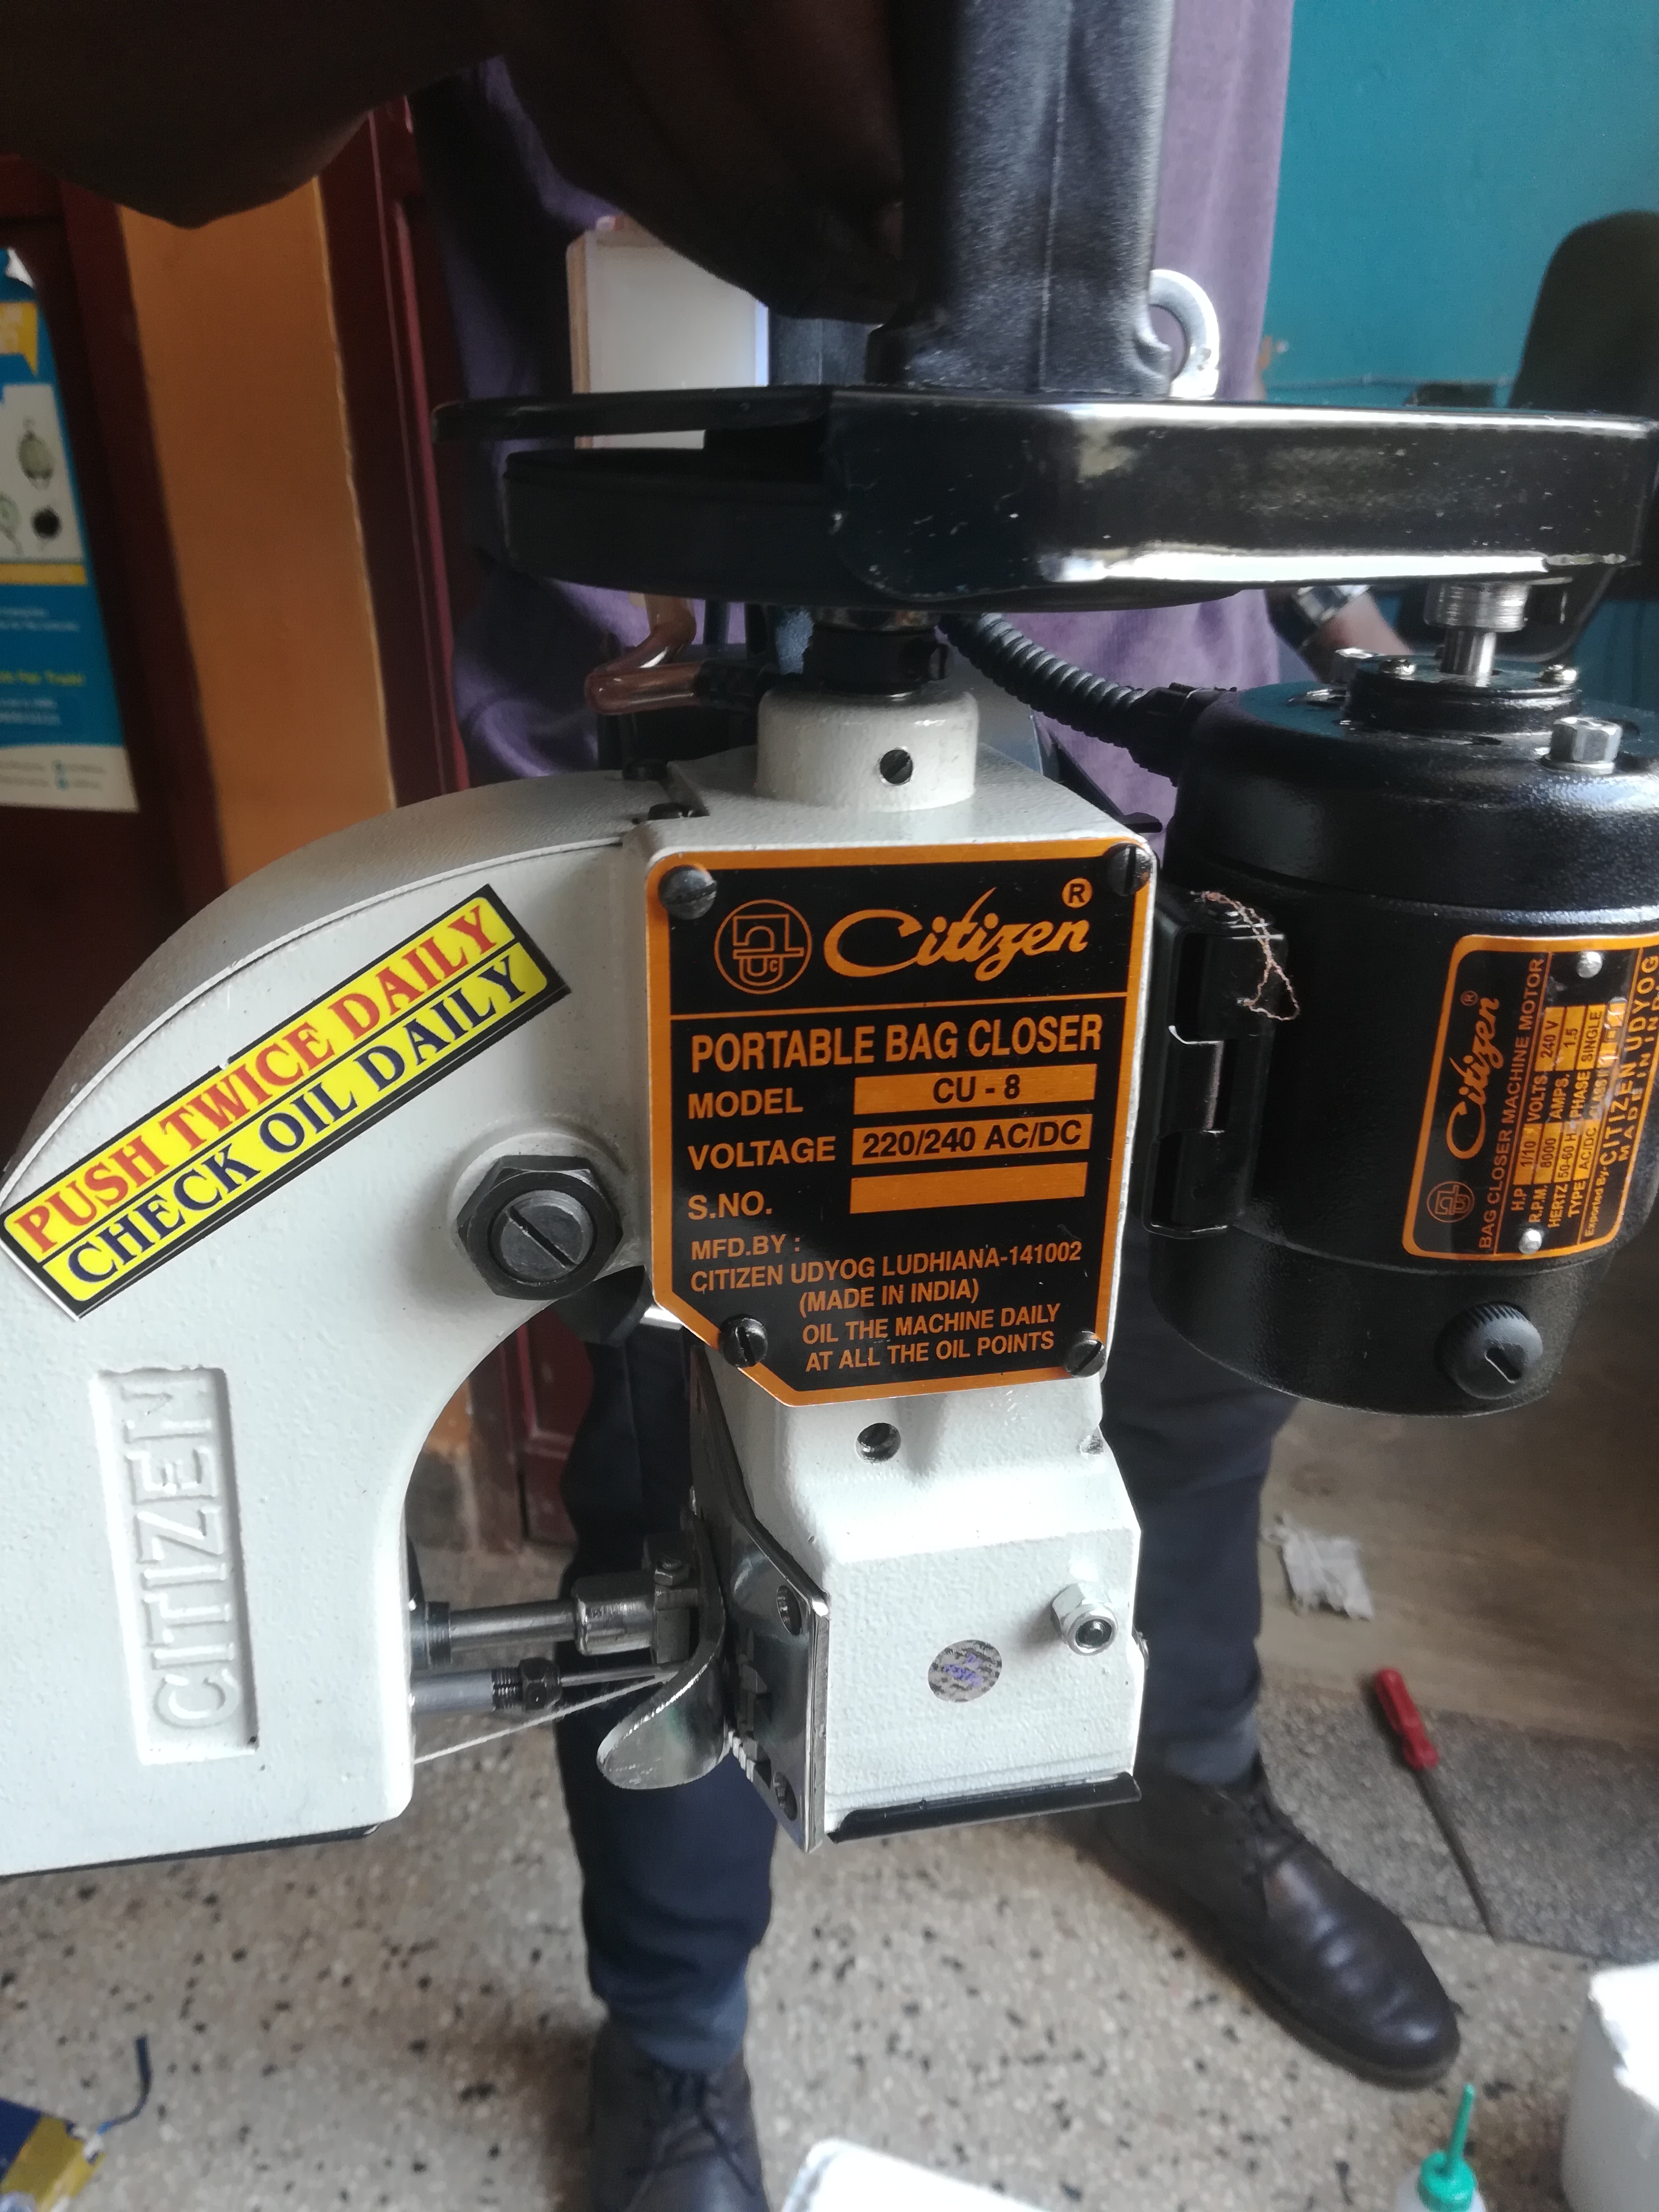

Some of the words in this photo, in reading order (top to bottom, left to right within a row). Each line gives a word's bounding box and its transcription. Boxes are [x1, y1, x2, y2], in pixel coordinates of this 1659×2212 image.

[824, 887, 1090, 982] Citizen
[1518, 958, 1545, 1030] MOTOR
[691, 1026, 875, 1073] PORTABLE
[886, 1021, 958, 1063] BAG
[968, 1014, 1103, 1058] CLOSER
[1540, 1034, 1556, 1059] 240
[1546, 1020, 1559, 1030] V
[1563, 1027, 1579, 1049] 1.5
[13, 1134, 170, 1255] PUSH
[159, 1022, 335, 1152] TWICE
[328, 905, 498, 1041] DAILY
[1446, 997, 1504, 1160] Citizen
[1501, 1036, 1530, 1123] MACHINE
[1569, 1070, 1591, 1118] PHASE
[1581, 1010, 1603, 1063] SINGLE
[1600, 1061, 1637, 1166] CITIZEN
[1624, 955, 1658, 1052] UDYOG
[68, 1142, 263, 1283] CHECK
[259, 1083, 358, 1154] OIL
[353, 956, 526, 1091] DAILY
[688, 1087, 804, 1119] MODEL
[933, 1075, 976, 1103] CU
[1005, 1074, 1021, 1099] 8
[1526, 1074, 1548, 1123] VOLTS
[687, 1136, 836, 1171] VOLTAGE
[861, 1126, 976, 1159] 220/240
[984, 1119, 1081, 1150] AC/DC
[1487, 1129, 1513, 1204] CLOSER
[1520, 1141, 1536, 1167] 1/10
[1540, 1137, 1557, 1168] 8000
[1567, 1180, 1587, 1218] TYPE
[1578, 1126, 1597, 1170] AC/DC
[688, 1190, 773, 1220] S.NO.
[1479, 1209, 1497, 1249] BAG
[1547, 1183, 1569, 1228] HERTZ
[691, 1234, 787, 1260] MFD.BY
[691, 1264, 783, 1292] CITIZEN
[790, 1257, 875, 1283] UDYOG
[882, 1240, 1082, 1277] LUDHIANA-141002
[799, 1286, 875, 1318] (MADE
[881, 1284, 904, 1306] IN
[910, 1278, 979, 1304] INDIA)
[802, 1323, 839, 1345] OIL
[845, 1318, 889, 1341] THE
[895, 1308, 994, 1337] MACHINE
[1001, 1303, 1061, 1327] DAILY
[806, 1350, 833, 1372] AT
[838, 1347, 881, 1369] ALL
[887, 1342, 929, 1364] THE
[936, 1338, 971, 1360] OIL
[977, 1330, 1055, 1356] POINTS
[120, 1379, 241, 1728] CITIZEN
